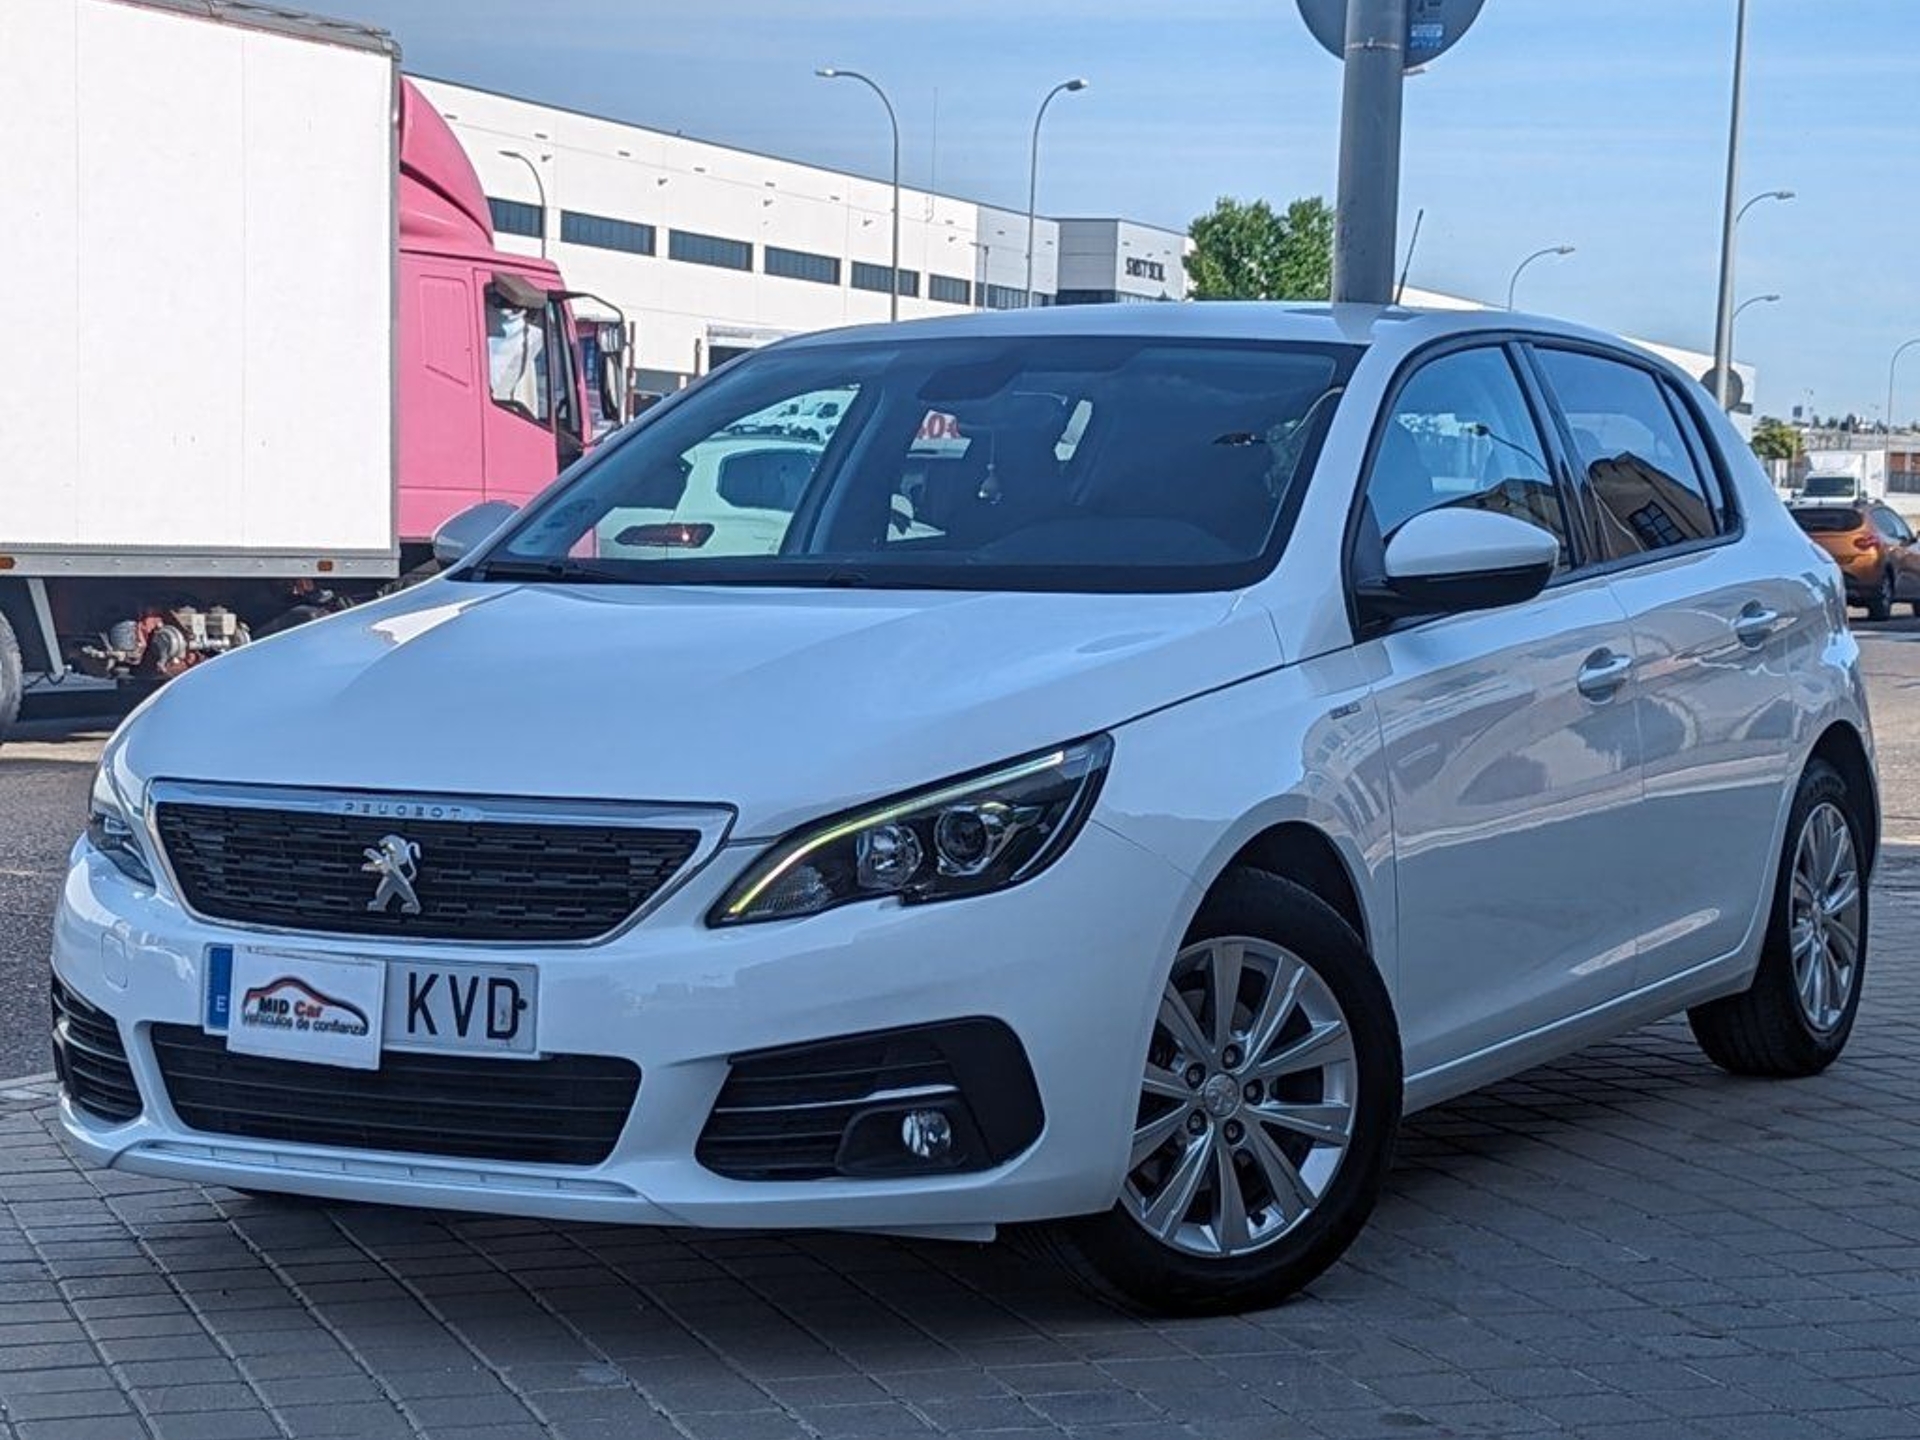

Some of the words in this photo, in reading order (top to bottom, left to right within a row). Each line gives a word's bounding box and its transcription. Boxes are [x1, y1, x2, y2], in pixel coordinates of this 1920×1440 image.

[344, 802, 462, 819] PEUGEOT
[216, 995, 227, 1013] E
[258, 996, 290, 1015] MID
[294, 1001, 324, 1018] Car
[407, 971, 521, 1041] KVD
[296, 1018, 310, 1031] de
[313, 1019, 367, 1037] confianza
